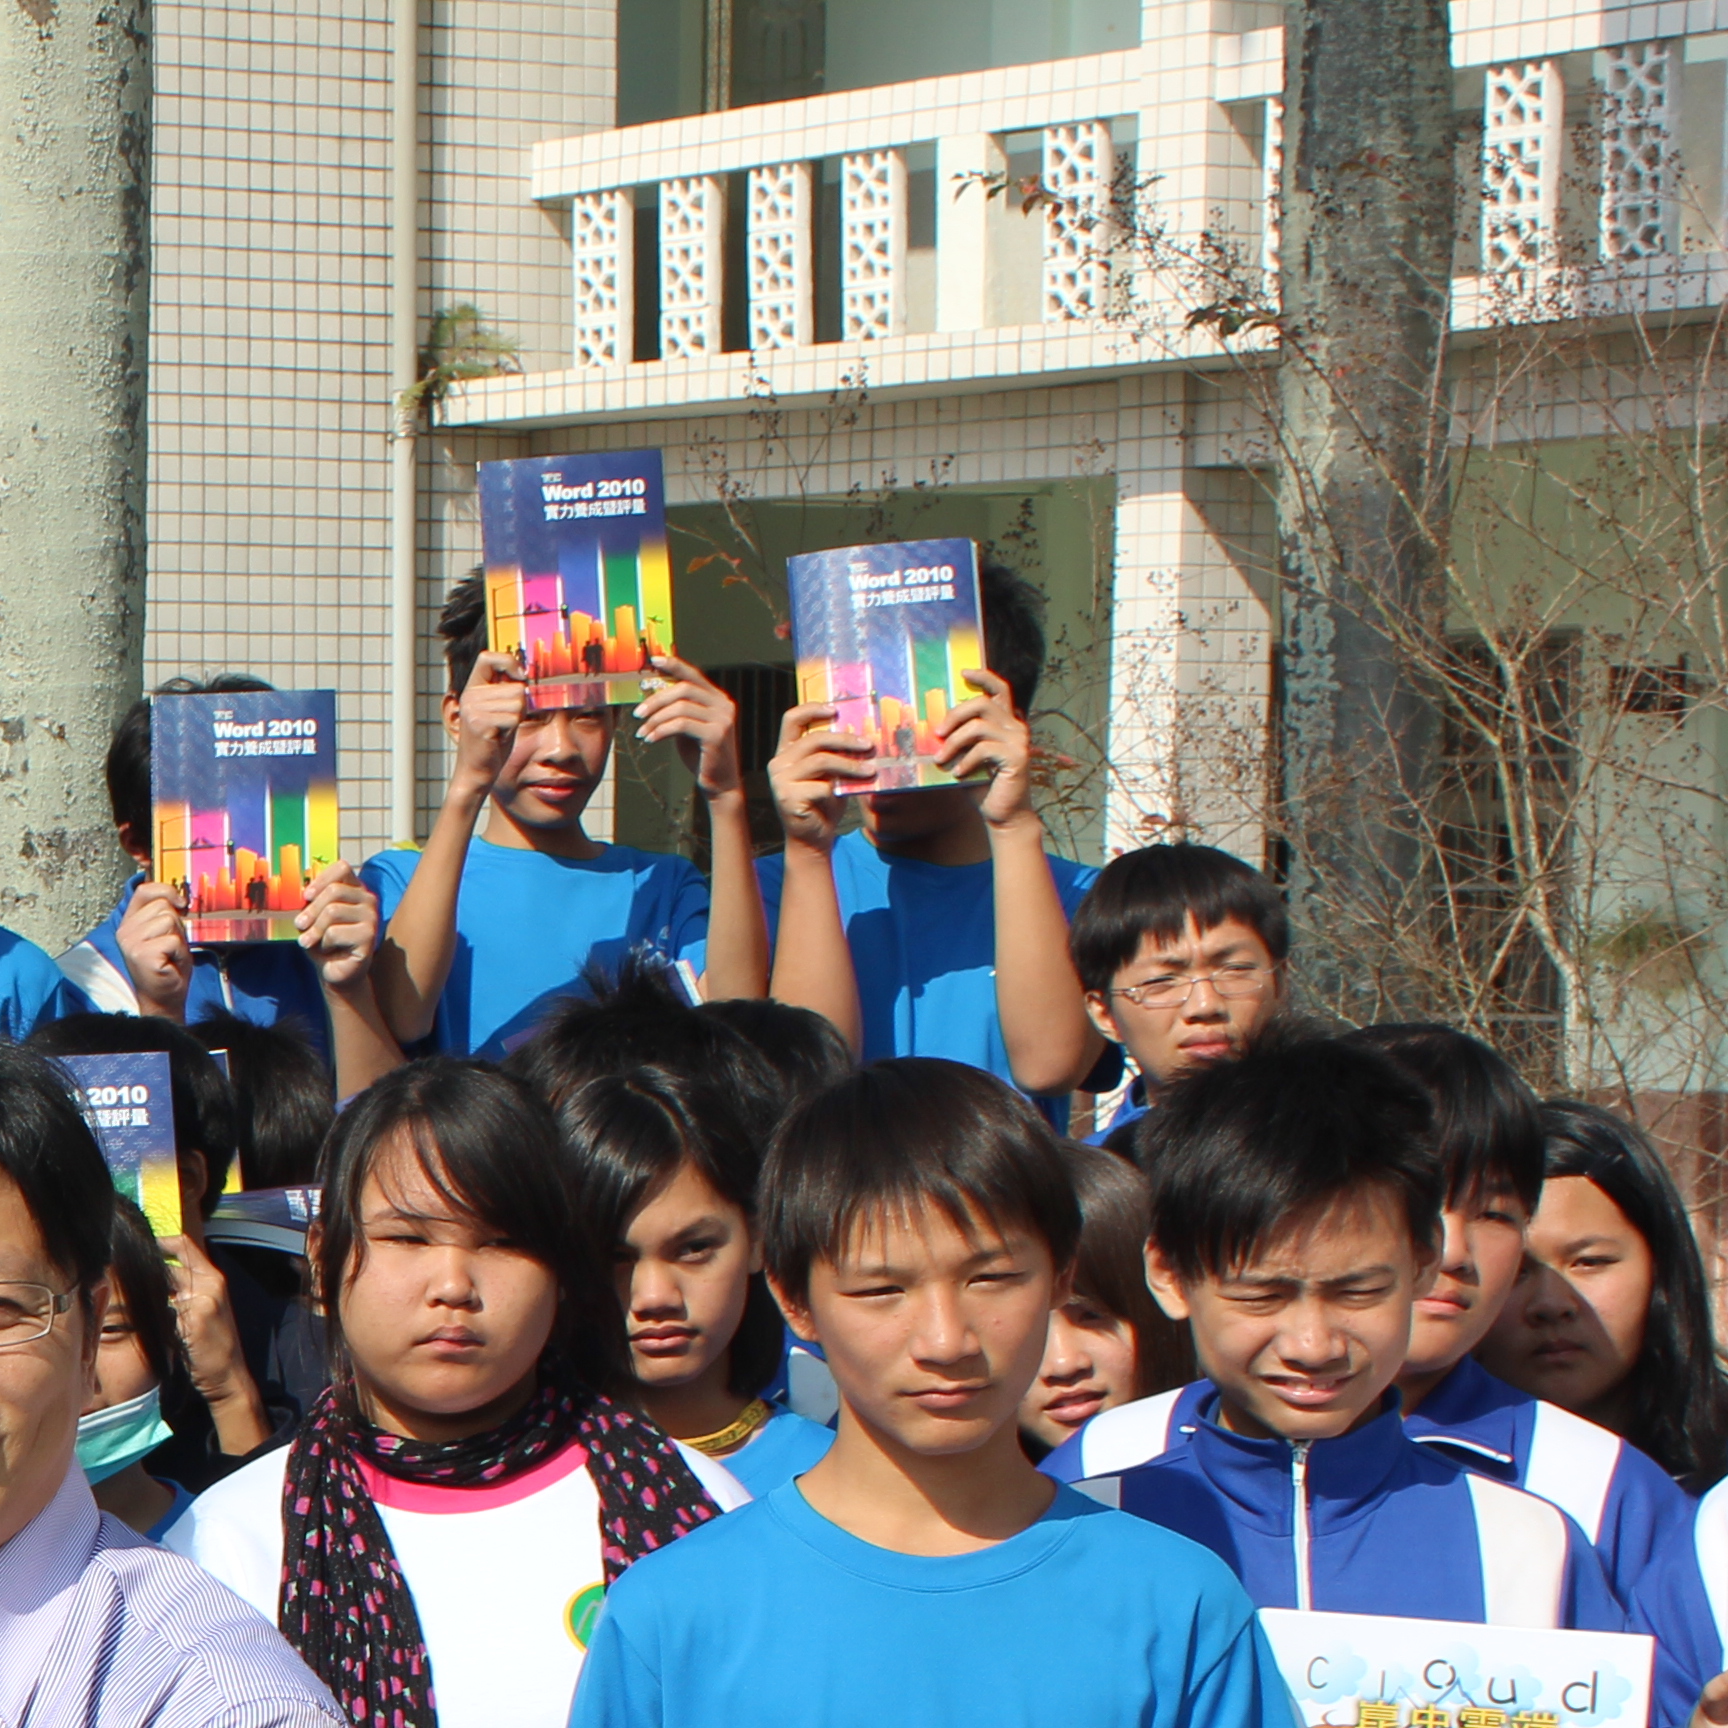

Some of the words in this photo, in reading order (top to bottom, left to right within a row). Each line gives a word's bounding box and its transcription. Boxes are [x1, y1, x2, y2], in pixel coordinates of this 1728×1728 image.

[542, 482, 593, 501] Word
[597, 478, 645, 498] 2010
[849, 570, 901, 591] Word
[904, 565, 954, 585] 2010
[213, 720, 264, 739] Word
[268, 719, 317, 737] 2010
[86, 1086, 148, 1106] 2010
